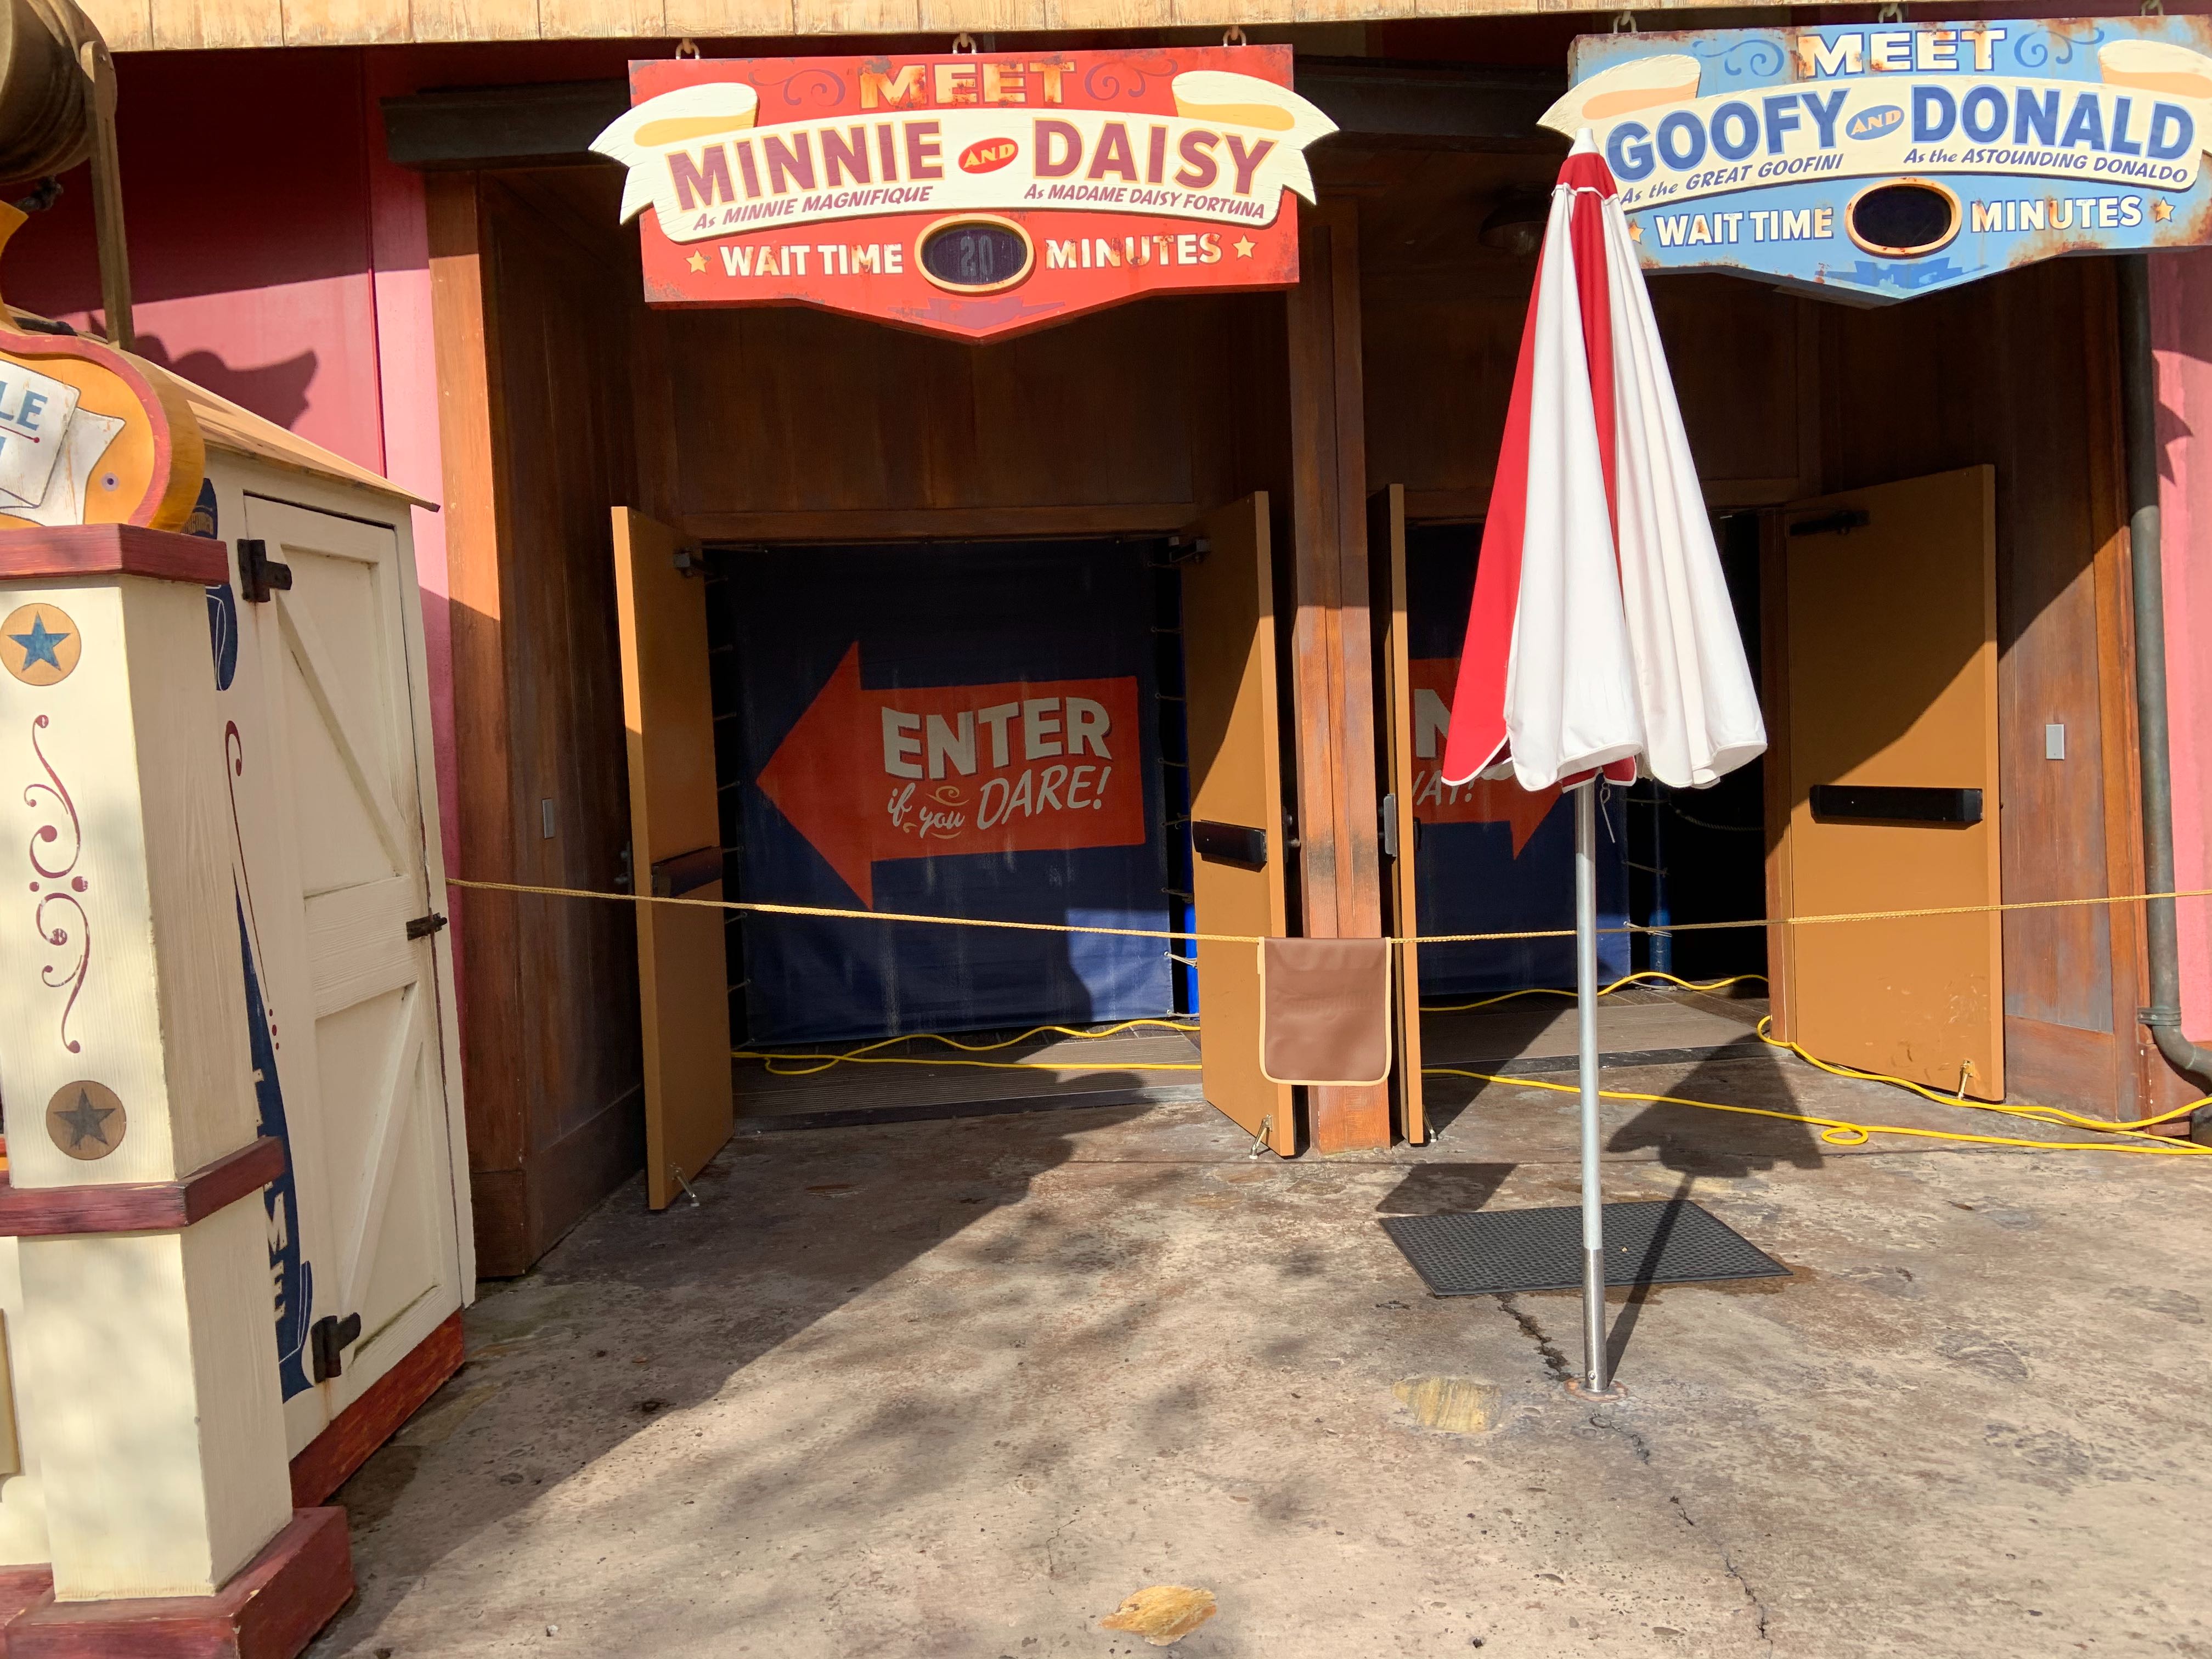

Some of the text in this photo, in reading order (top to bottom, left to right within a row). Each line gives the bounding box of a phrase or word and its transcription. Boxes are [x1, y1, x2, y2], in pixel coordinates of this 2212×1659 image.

[1796, 27, 2007, 80] MEET
[859, 60, 1077, 110] MEET
[1605, 84, 2194, 183] GOOFY AND DONALD
[665, 117, 1279, 213] MINNIE AND DAISY
[1621, 154, 1843, 205] As the GREAT GOOFINI
[1904, 148, 2187, 183] As the ASTOUNDING DONALDO
[693, 187, 933, 231] As MINNIE MAGNIFIQUE
[1024, 184, 1265, 218] As MADAME DAISY FORTUNA
[1654, 195, 2142, 247] WAIT TIME MINUTES
[719, 233, 1223, 276] WAIT TIME 20 MINUTES
[882, 697, 1113, 780] ENTER
[887, 765, 1111, 839] if you DARE!
